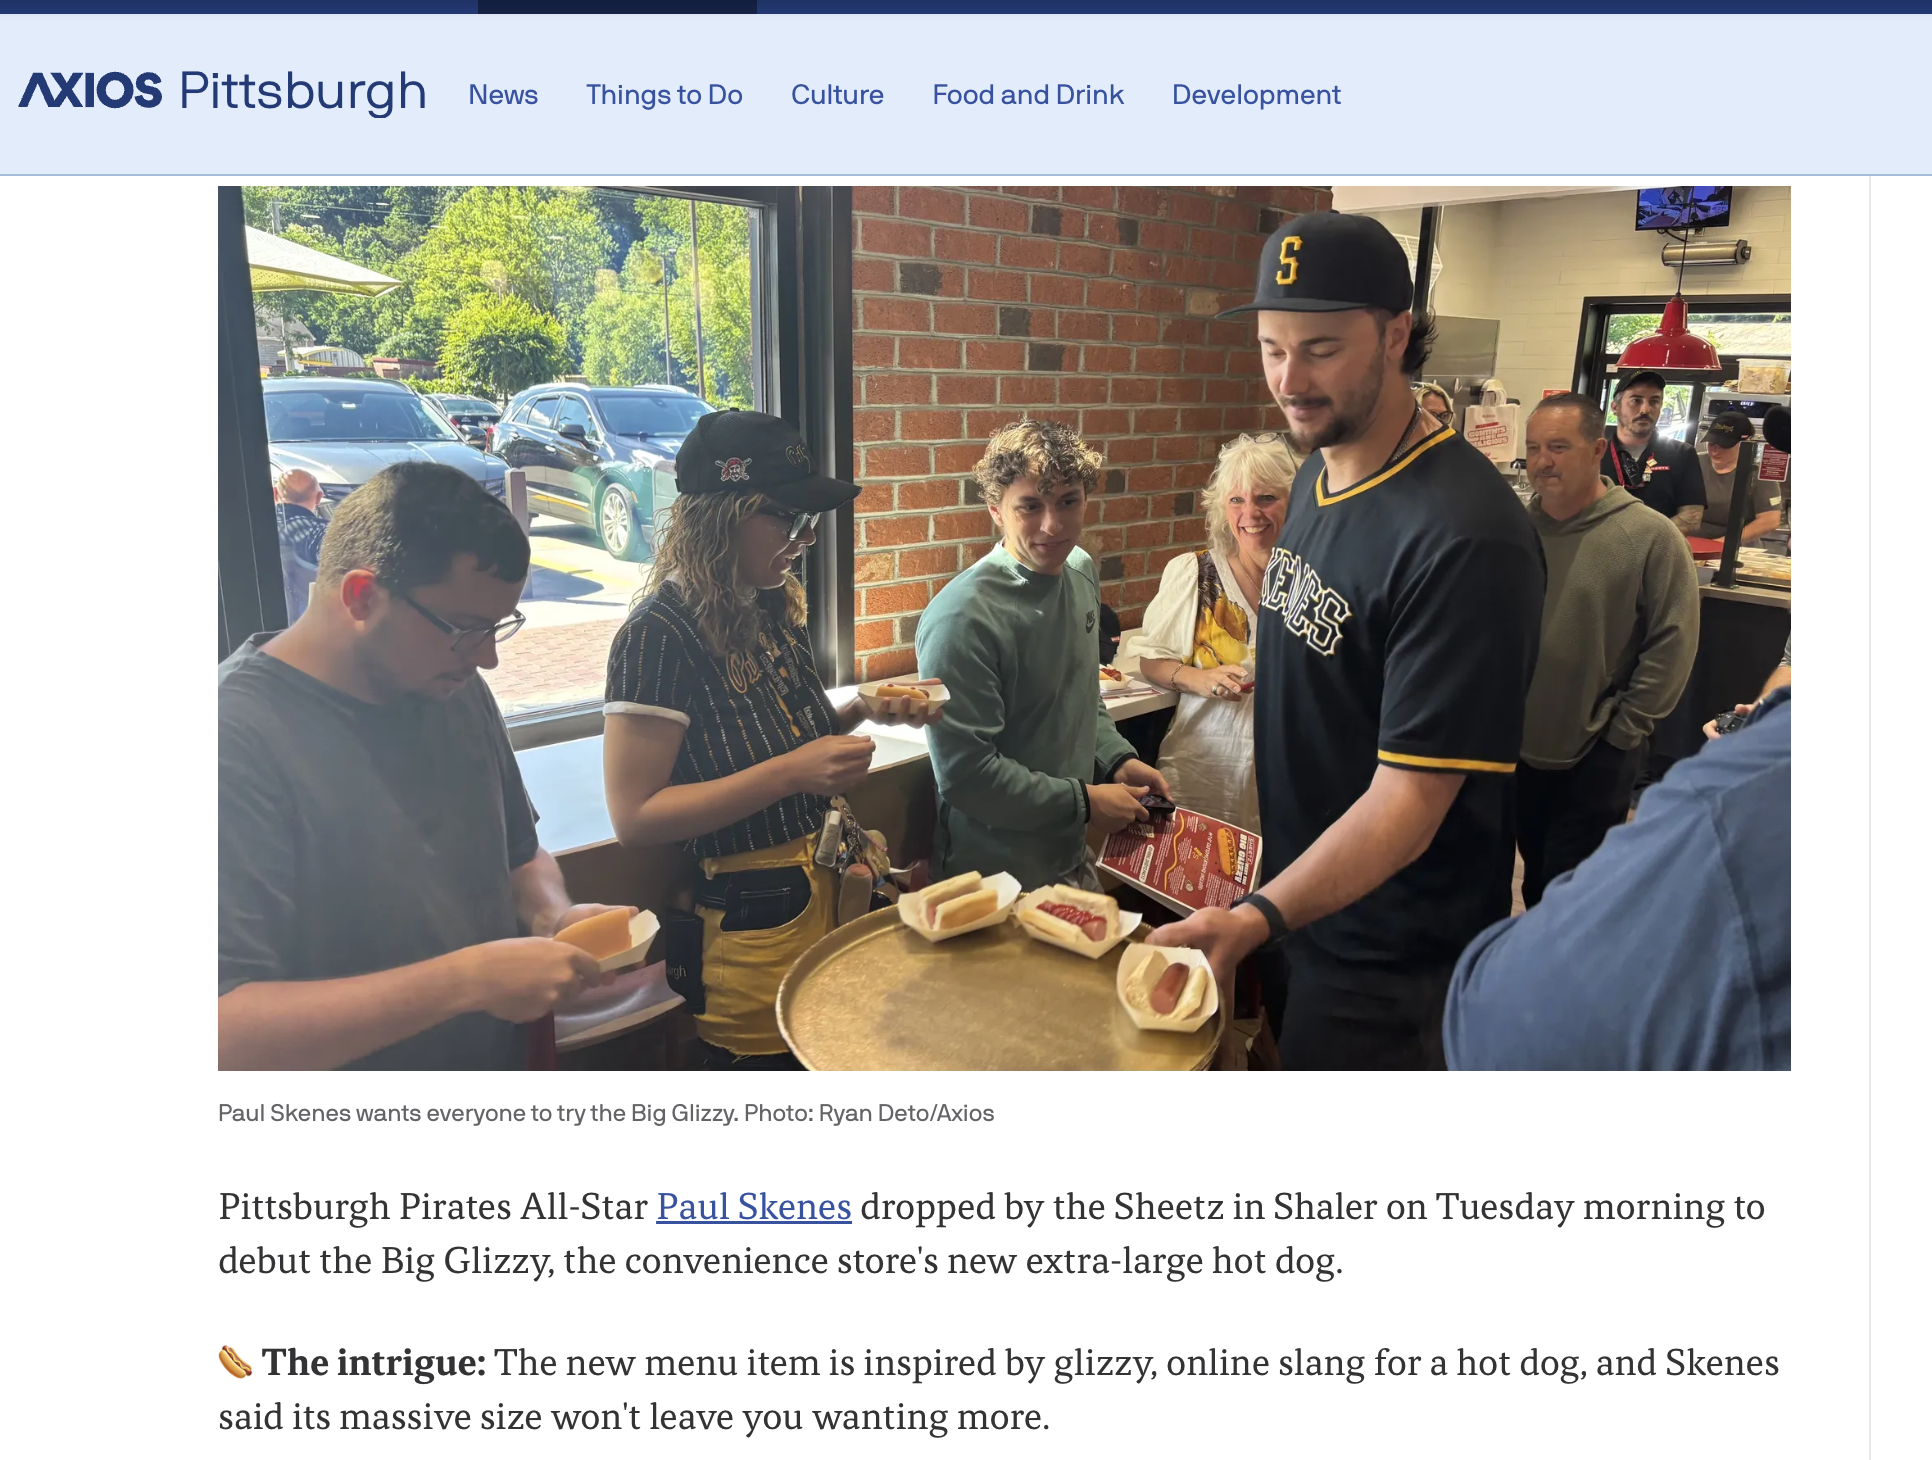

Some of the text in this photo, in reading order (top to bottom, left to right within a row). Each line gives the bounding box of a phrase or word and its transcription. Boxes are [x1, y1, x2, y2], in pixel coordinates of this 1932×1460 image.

[1276, 236, 1303, 285] S
[1261, 546, 1353, 657] KENES
[1239, 833, 1248, 850] BIG
